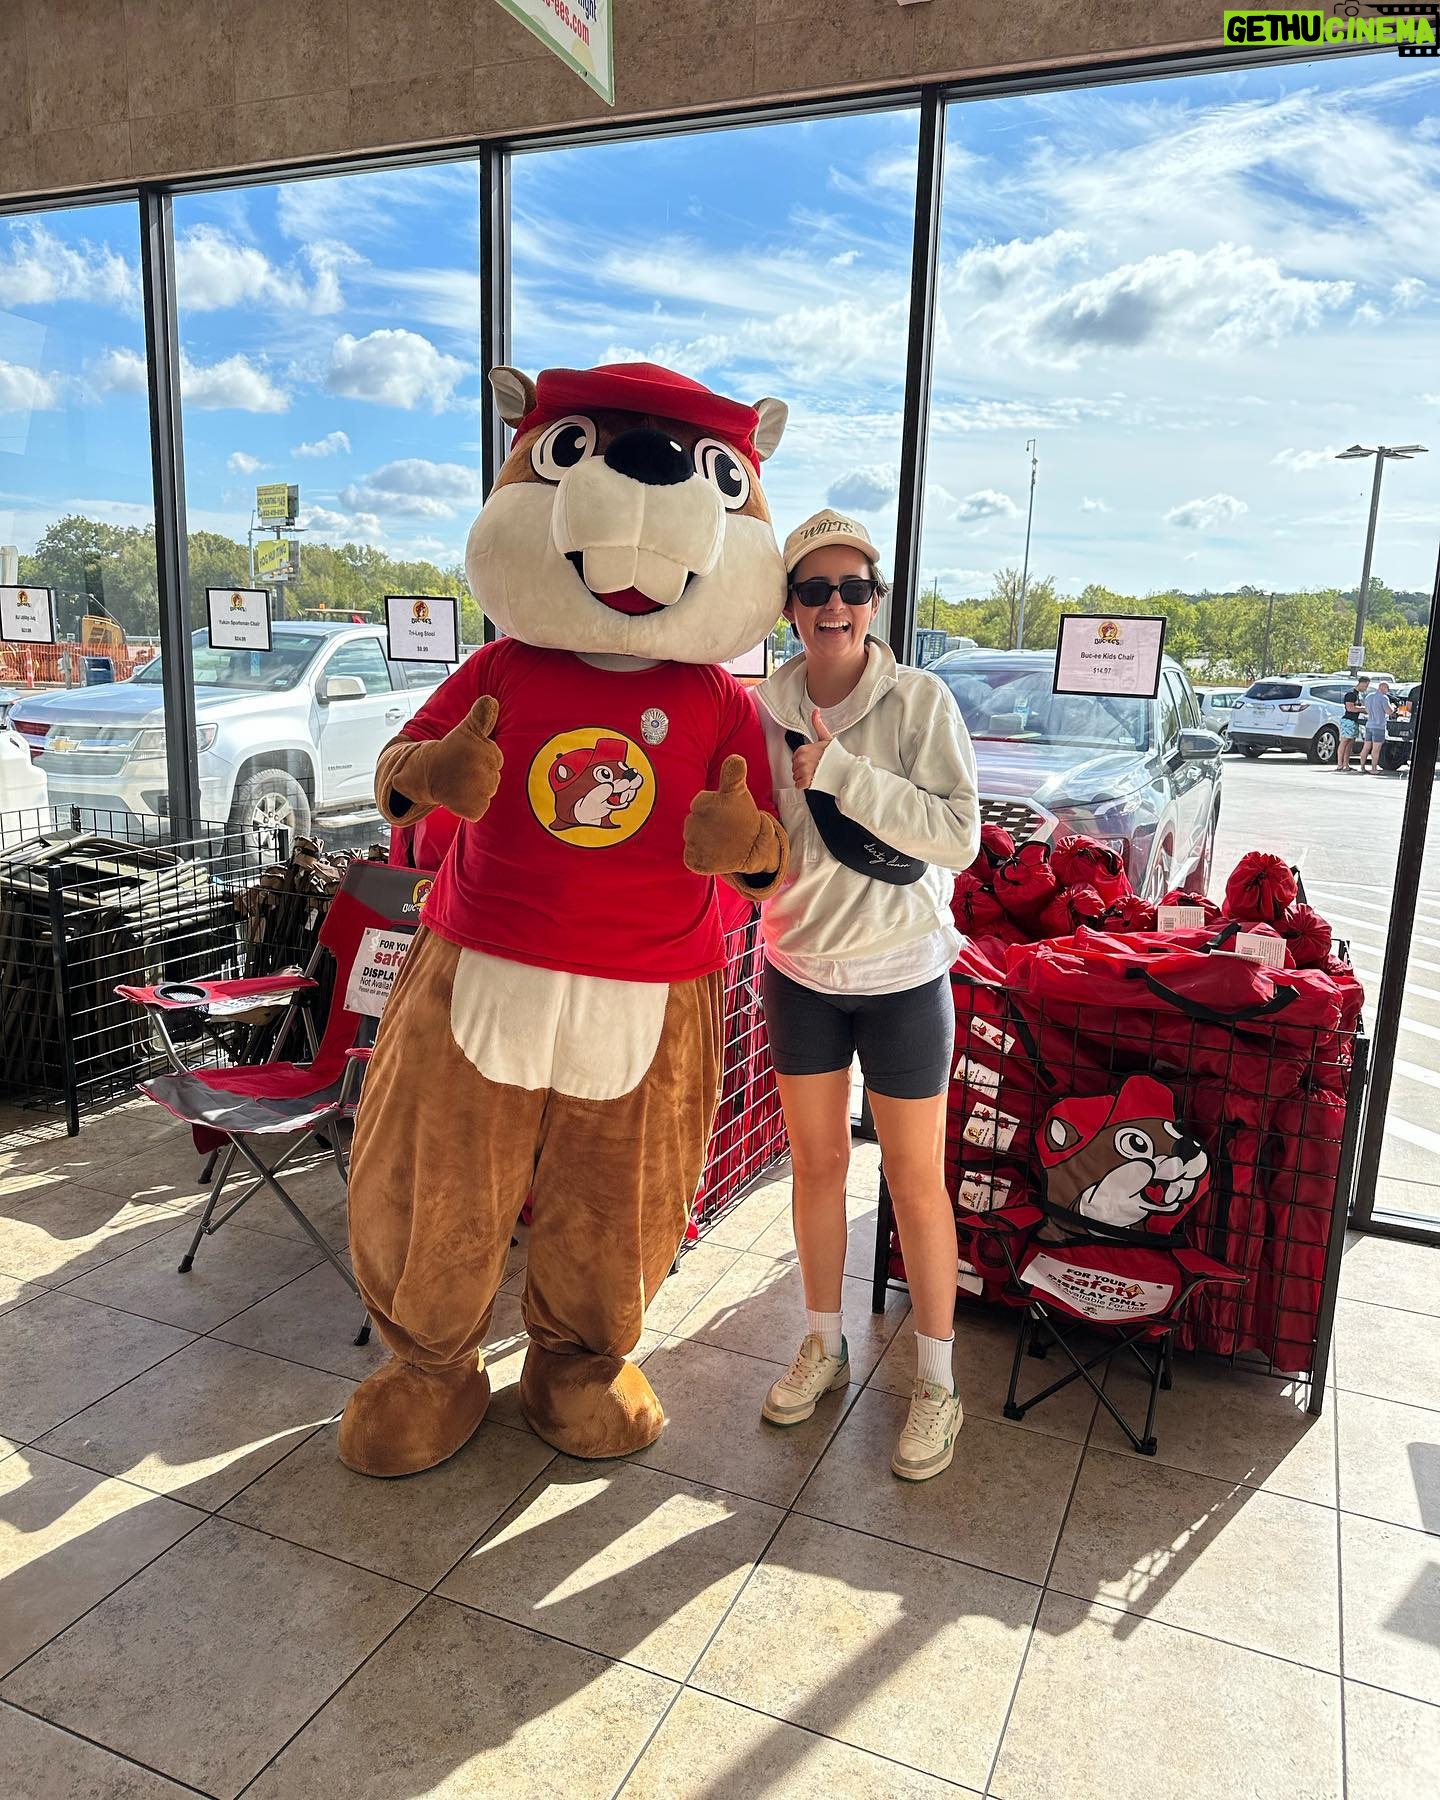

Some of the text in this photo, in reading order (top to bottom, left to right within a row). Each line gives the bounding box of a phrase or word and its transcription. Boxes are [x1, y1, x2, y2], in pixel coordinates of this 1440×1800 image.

[1102, 652, 1117, 660] Kids
[1117, 653, 1135, 661] Chair
[379, 940, 395, 950] FOR
[359, 977, 371, 987] Not
[362, 967, 397, 982] DISPLA
[1066, 1268, 1128, 1288] FOR YOUR
[1047, 1273, 1107, 1300] DISPLAY
[1109, 1297, 1148, 1307] ONLY
[1060, 1274, 1139, 1300] safety
[1063, 1287, 1106, 1305] Available
